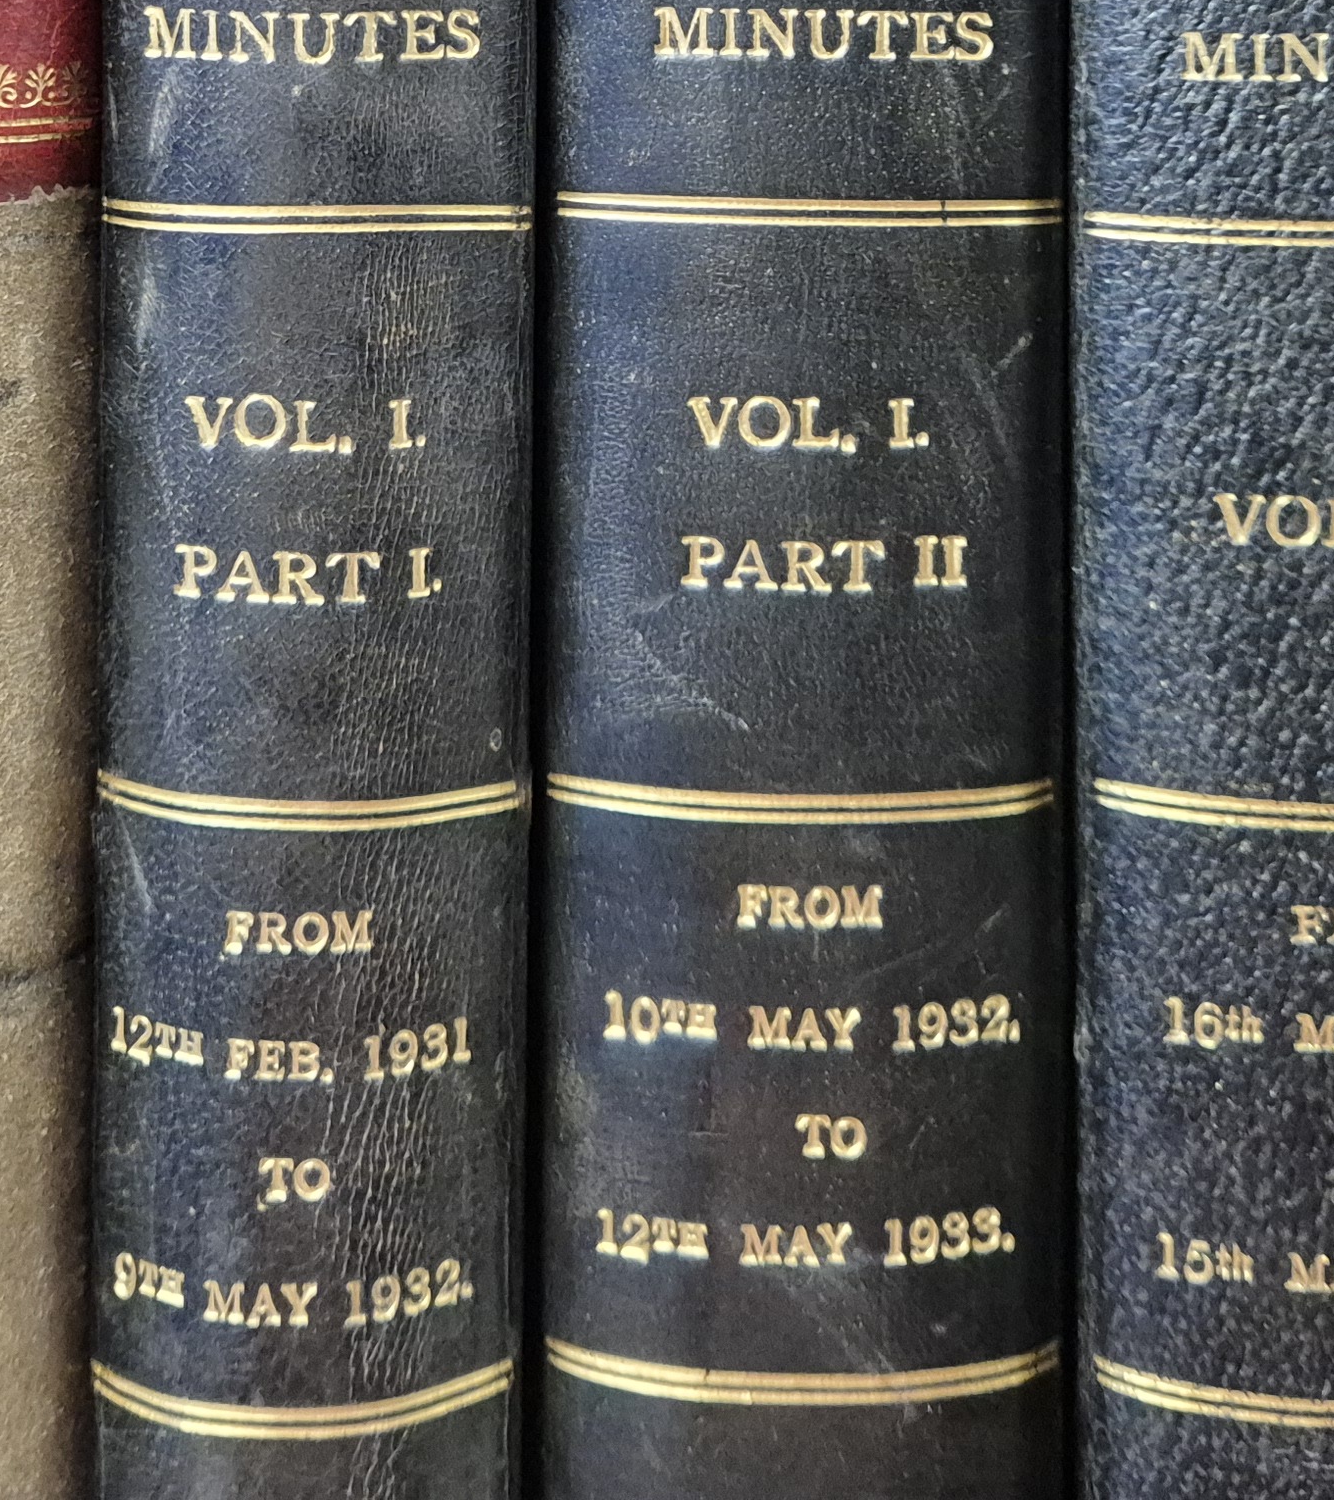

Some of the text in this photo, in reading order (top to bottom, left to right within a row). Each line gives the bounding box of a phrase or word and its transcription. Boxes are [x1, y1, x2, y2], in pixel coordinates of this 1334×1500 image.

[143, 5, 480, 64] MINUTES
[653, 7, 994, 61] MINUTES
[185, 393, 426, 454] VOL. I.
[687, 396, 929, 454] VOL. I.
[173, 544, 442, 605] PART I.
[681, 535, 967, 593] PART II
[224, 910, 374, 955] FROM
[737, 883, 883, 929] FROM
[110, 1006, 472, 1084] 12TH FEB. 1931
[603, 989, 717, 1045] 10TH
[747, 1006, 861, 1051] MAY
[1163, 996, 1264, 1049] 16th
[795, 1113, 867, 1160] TO
[258, 1158, 332, 1203] TO
[596, 1206, 1015, 1268] 12TH MAY 1933.
[1154, 1232, 1254, 1285] 15th
[114, 1252, 473, 1328] 9TH MAY 1932.
